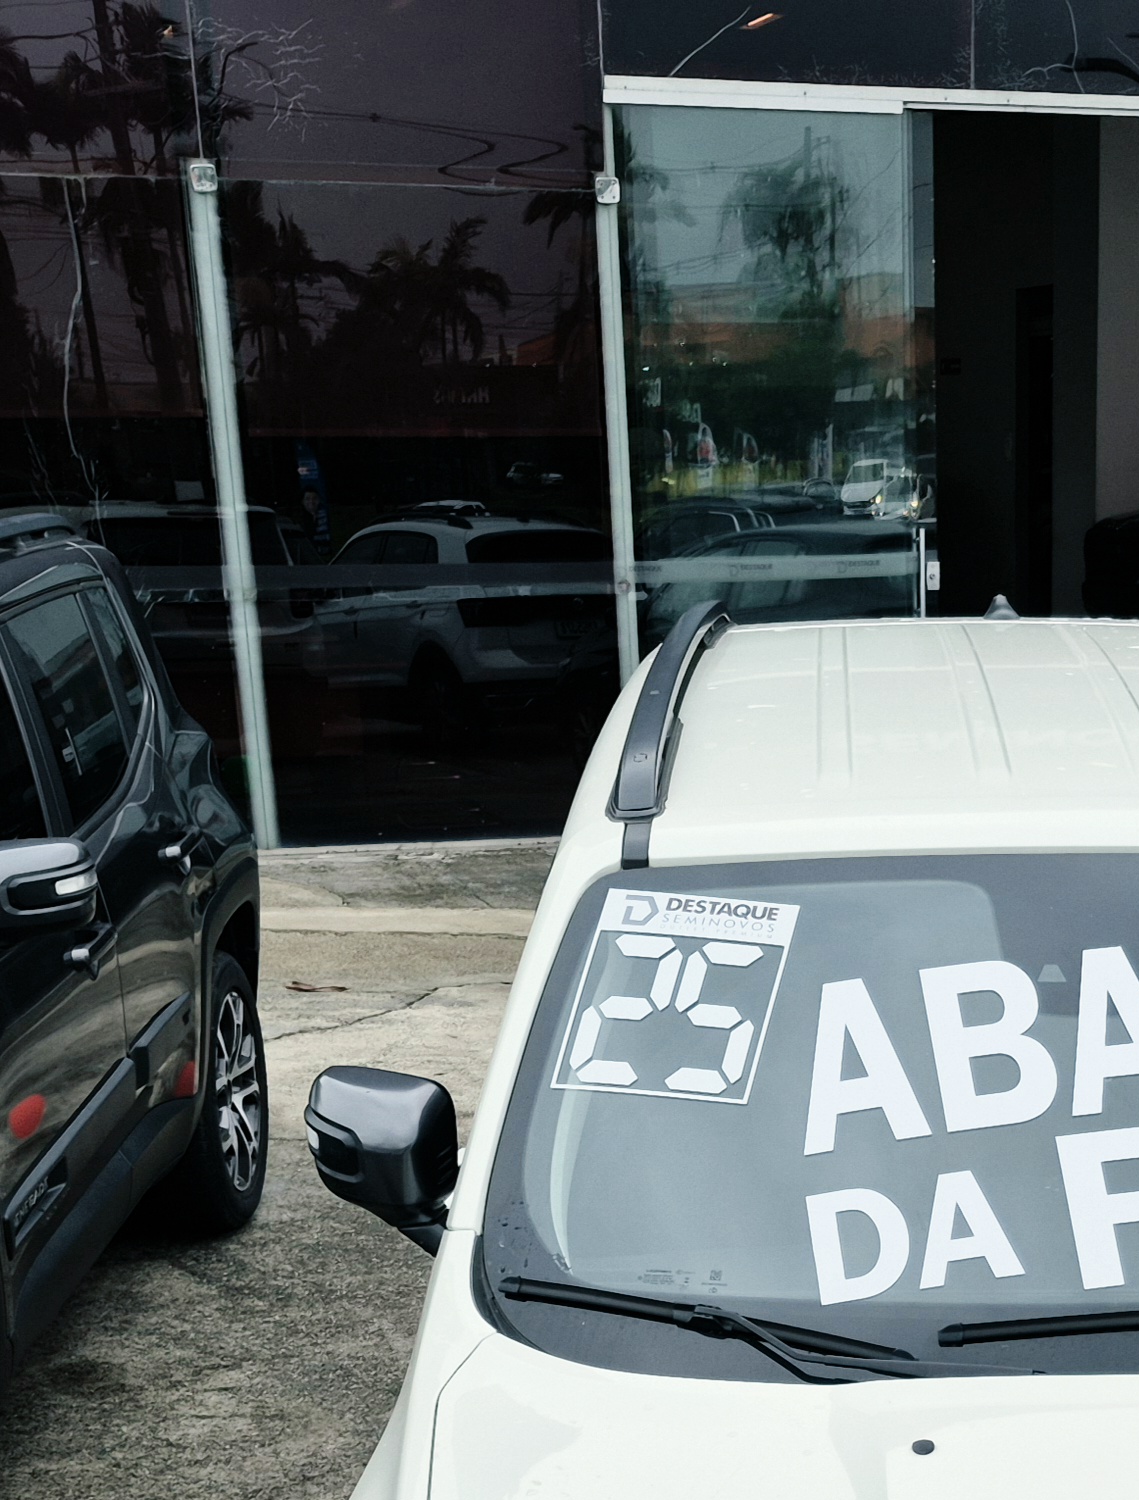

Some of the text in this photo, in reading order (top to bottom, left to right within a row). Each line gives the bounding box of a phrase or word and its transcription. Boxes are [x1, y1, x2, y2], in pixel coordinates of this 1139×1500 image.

[662, 913, 776, 934] SEMINOVOS
[665, 897, 780, 922] DESTAQUE
[569, 933, 765, 1095] 25
[804, 1170, 1026, 1306] DA
